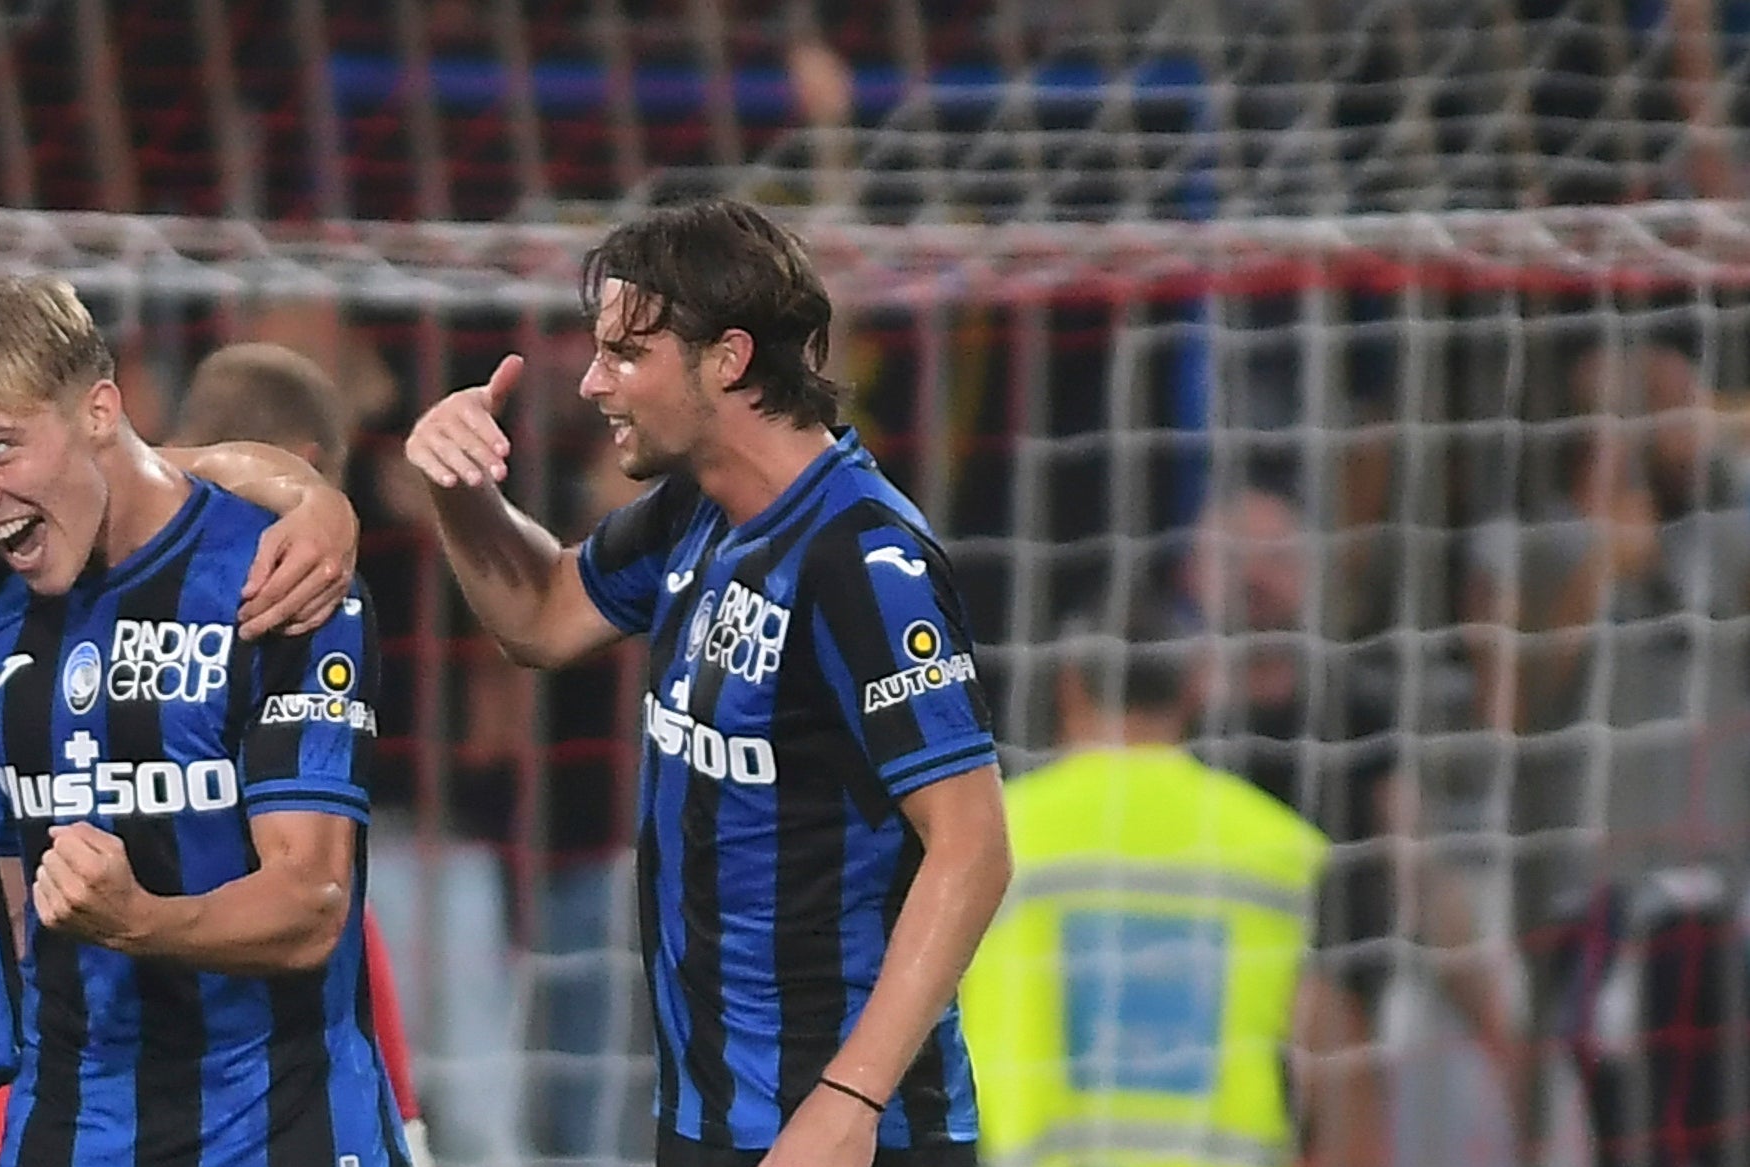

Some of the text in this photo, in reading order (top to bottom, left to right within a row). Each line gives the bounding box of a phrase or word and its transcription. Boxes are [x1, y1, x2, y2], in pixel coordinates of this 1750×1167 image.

[717, 578, 790, 651] RADICI
[110, 619, 234, 666] RADICI
[705, 622, 781, 684] GROUP
[107, 661, 227, 703] GROUP
